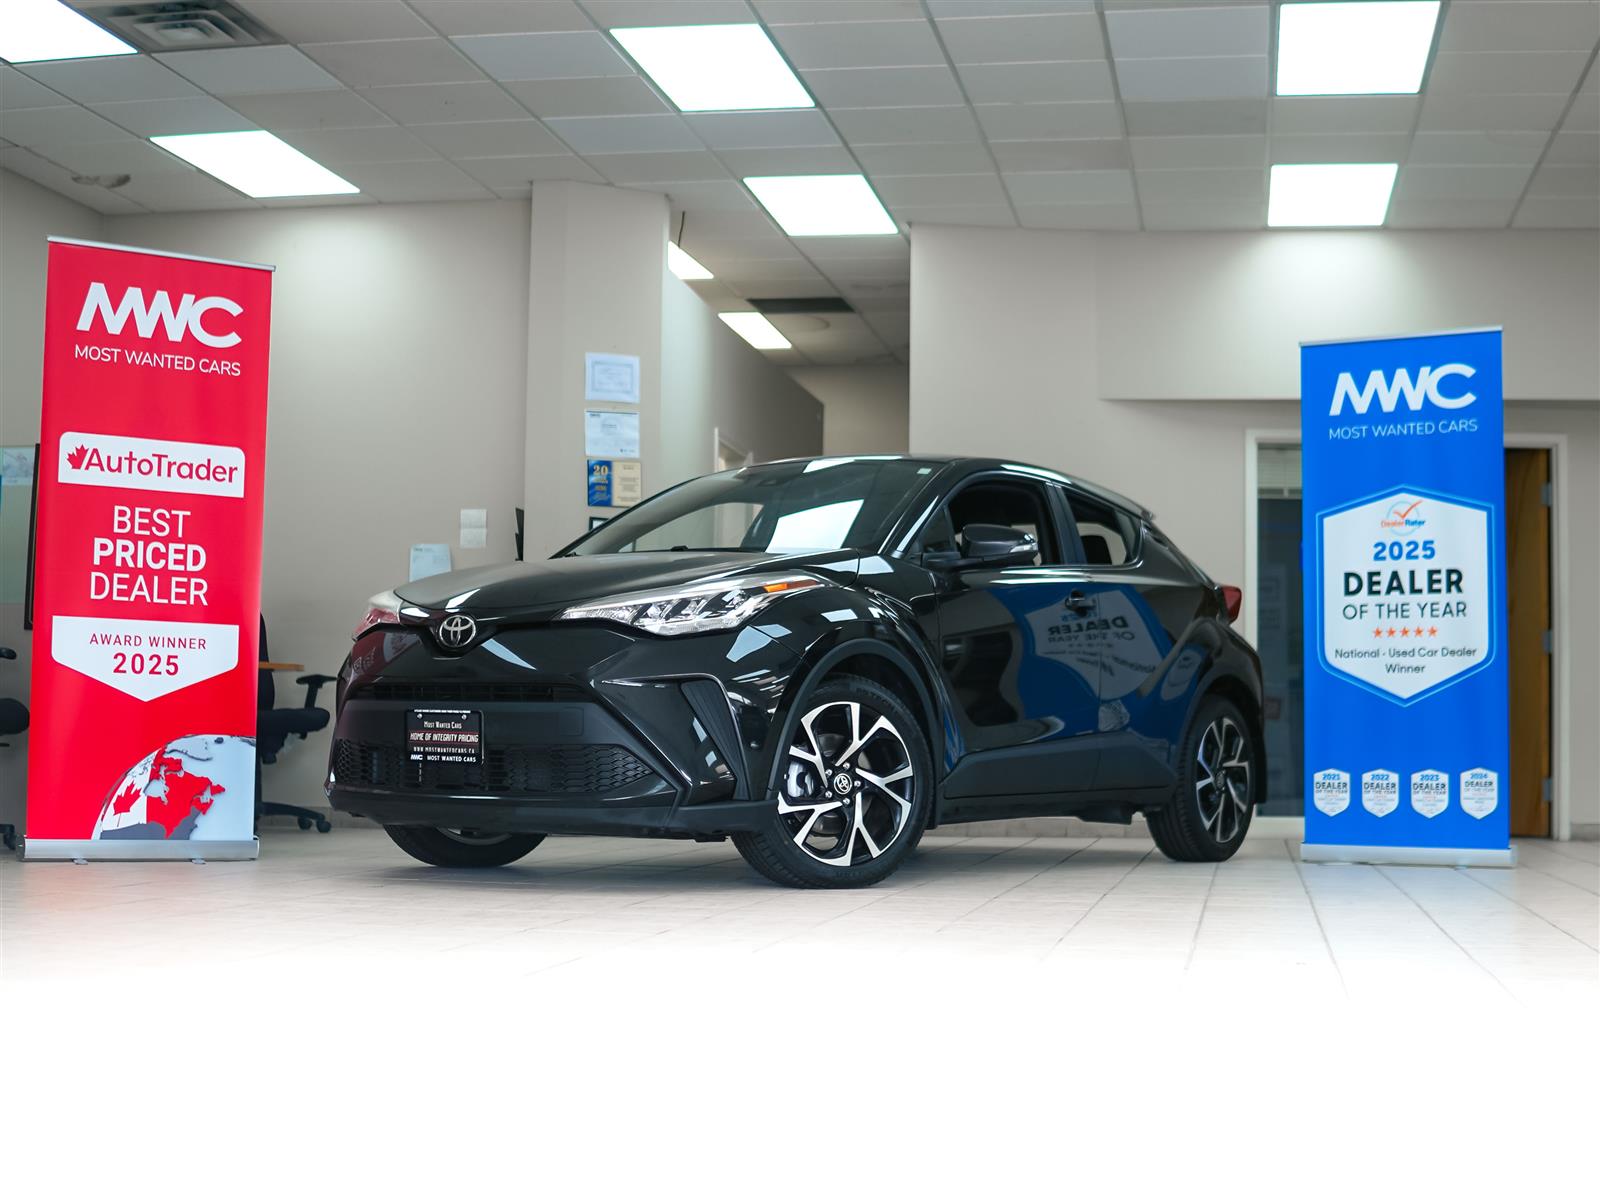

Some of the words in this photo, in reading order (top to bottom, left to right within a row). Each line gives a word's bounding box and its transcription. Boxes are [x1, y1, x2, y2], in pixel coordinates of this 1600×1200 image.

[76, 281, 243, 348] MWC
[74, 344, 121, 363] MOST
[125, 350, 195, 371] WANTED
[199, 358, 241, 376] CARS
[1329, 363, 1477, 416] MWC
[1329, 426, 1368, 440] MOST
[1372, 421, 1435, 437] WANTED
[1439, 419, 1478, 433] CARS
[84, 448, 238, 483] AutoTrader
[113, 505, 191, 538] BEST
[93, 537, 207, 572] PRICED
[1373, 540, 1436, 561] 2025
[90, 571, 208, 606] DEALER
[1343, 569, 1463, 596] DEALER
[1342, 603, 1368, 620] OF
[1375, 603, 1410, 619] THE
[1417, 601, 1467, 618] YEAR
[89, 633, 143, 647] AWARD
[148, 635, 207, 650] WINNER
[1334, 647, 1380, 659] National
[1388, 647, 1416, 658] Used
[1418, 647, 1438, 658] Car
[1441, 646, 1477, 657] Dealer
[113, 652, 179, 676] 2025
[1385, 663, 1426, 674] Winner
[1364, 782, 1396, 790] DEALER
[1412, 782, 1446, 790] DEALER
